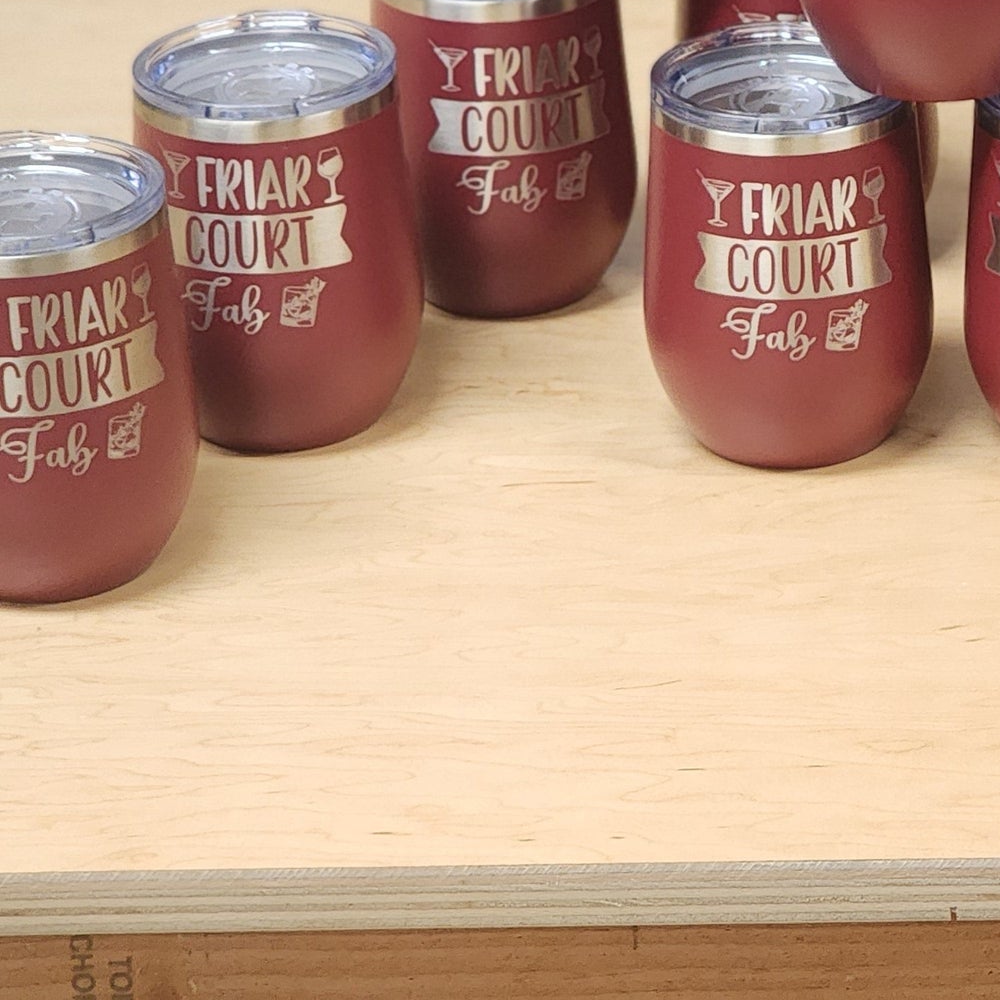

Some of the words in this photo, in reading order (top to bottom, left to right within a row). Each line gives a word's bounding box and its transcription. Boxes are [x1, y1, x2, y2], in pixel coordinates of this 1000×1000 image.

[473, 36, 580, 97] FRIAR
[461, 92, 582, 153] COURT
[196, 154, 312, 211] FRIAR
[455, 159, 548, 216] Fab
[741, 176, 858, 236] FRIAR
[185, 215, 314, 269] COURT
[727, 237, 859, 294] COURT
[7, 276, 128, 351] FRIAR
[181, 276, 271, 335] Fab
[720, 302, 816, 361] Fab
[0, 338, 132, 413] COURT
[0, 419, 98, 484] Fab
